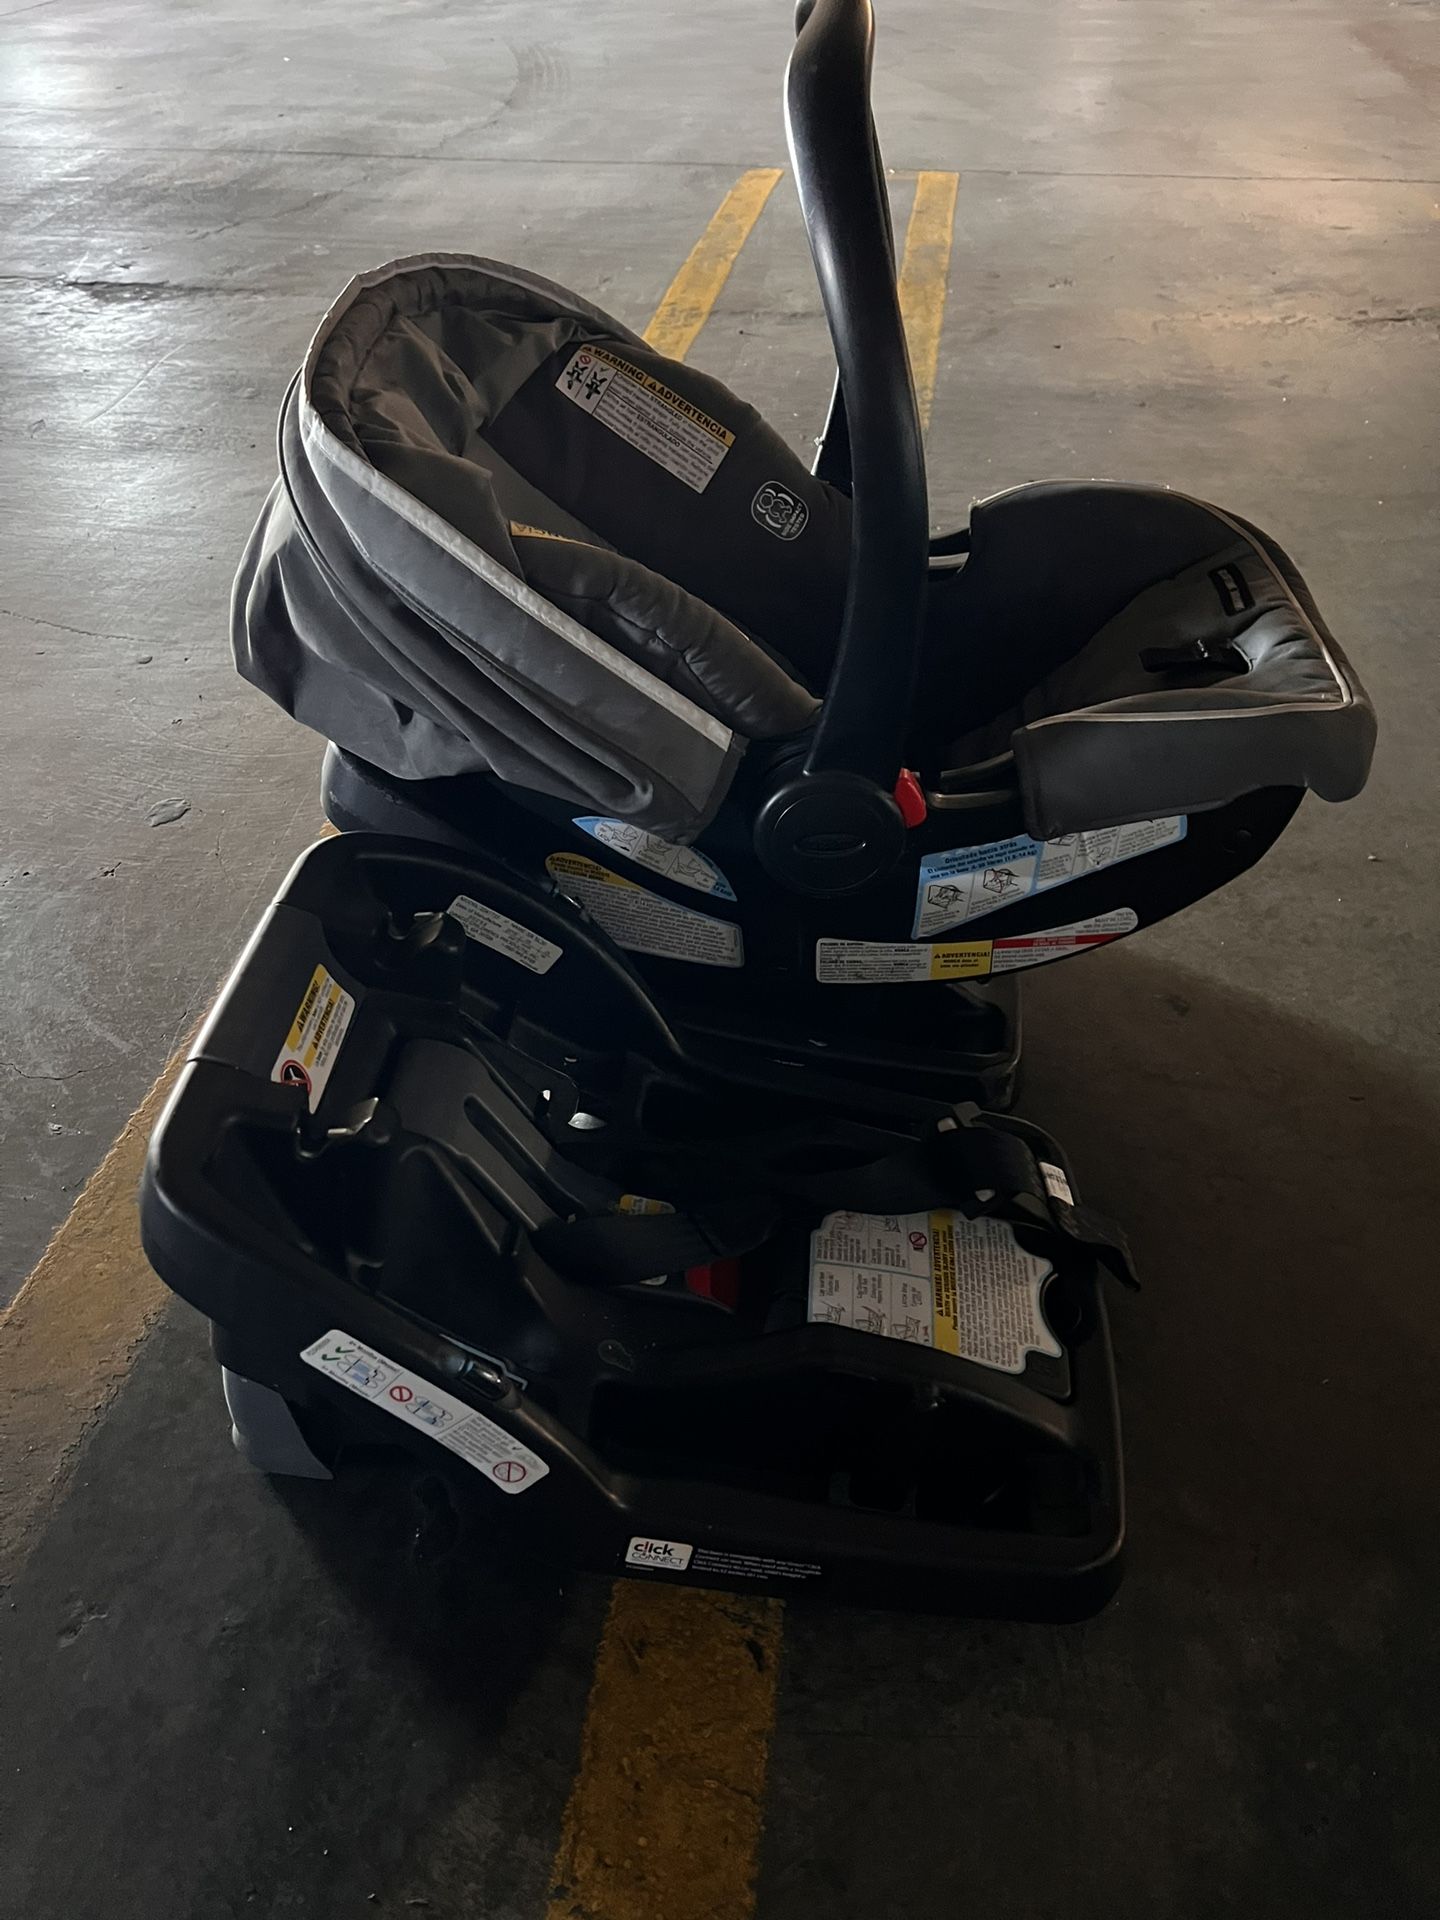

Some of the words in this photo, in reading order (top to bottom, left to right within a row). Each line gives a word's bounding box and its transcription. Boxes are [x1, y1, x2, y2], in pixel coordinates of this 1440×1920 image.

[592, 348, 644, 382] WARNING
[648, 394, 683, 422] STRANGLED
[654, 384, 728, 439] ADVERTENCIA
[635, 414, 681, 448] ESTRANGULADO
[780, 522, 792, 537] SIDE
[788, 502, 803, 524] IMPACT
[790, 512, 806, 534] TESTED
[941, 950, 990, 958] ADVERTENCIA!
[297, 979, 321, 1024] WARNING!
[312, 997, 335, 1043] ADVERTENCIA!
[932, 1228, 941, 1271] ADVERTENCIA!
[935, 1273, 944, 1308] WARNING!
[630, 1551, 683, 1565] CONNECT
[633, 1540, 675, 1556] click
